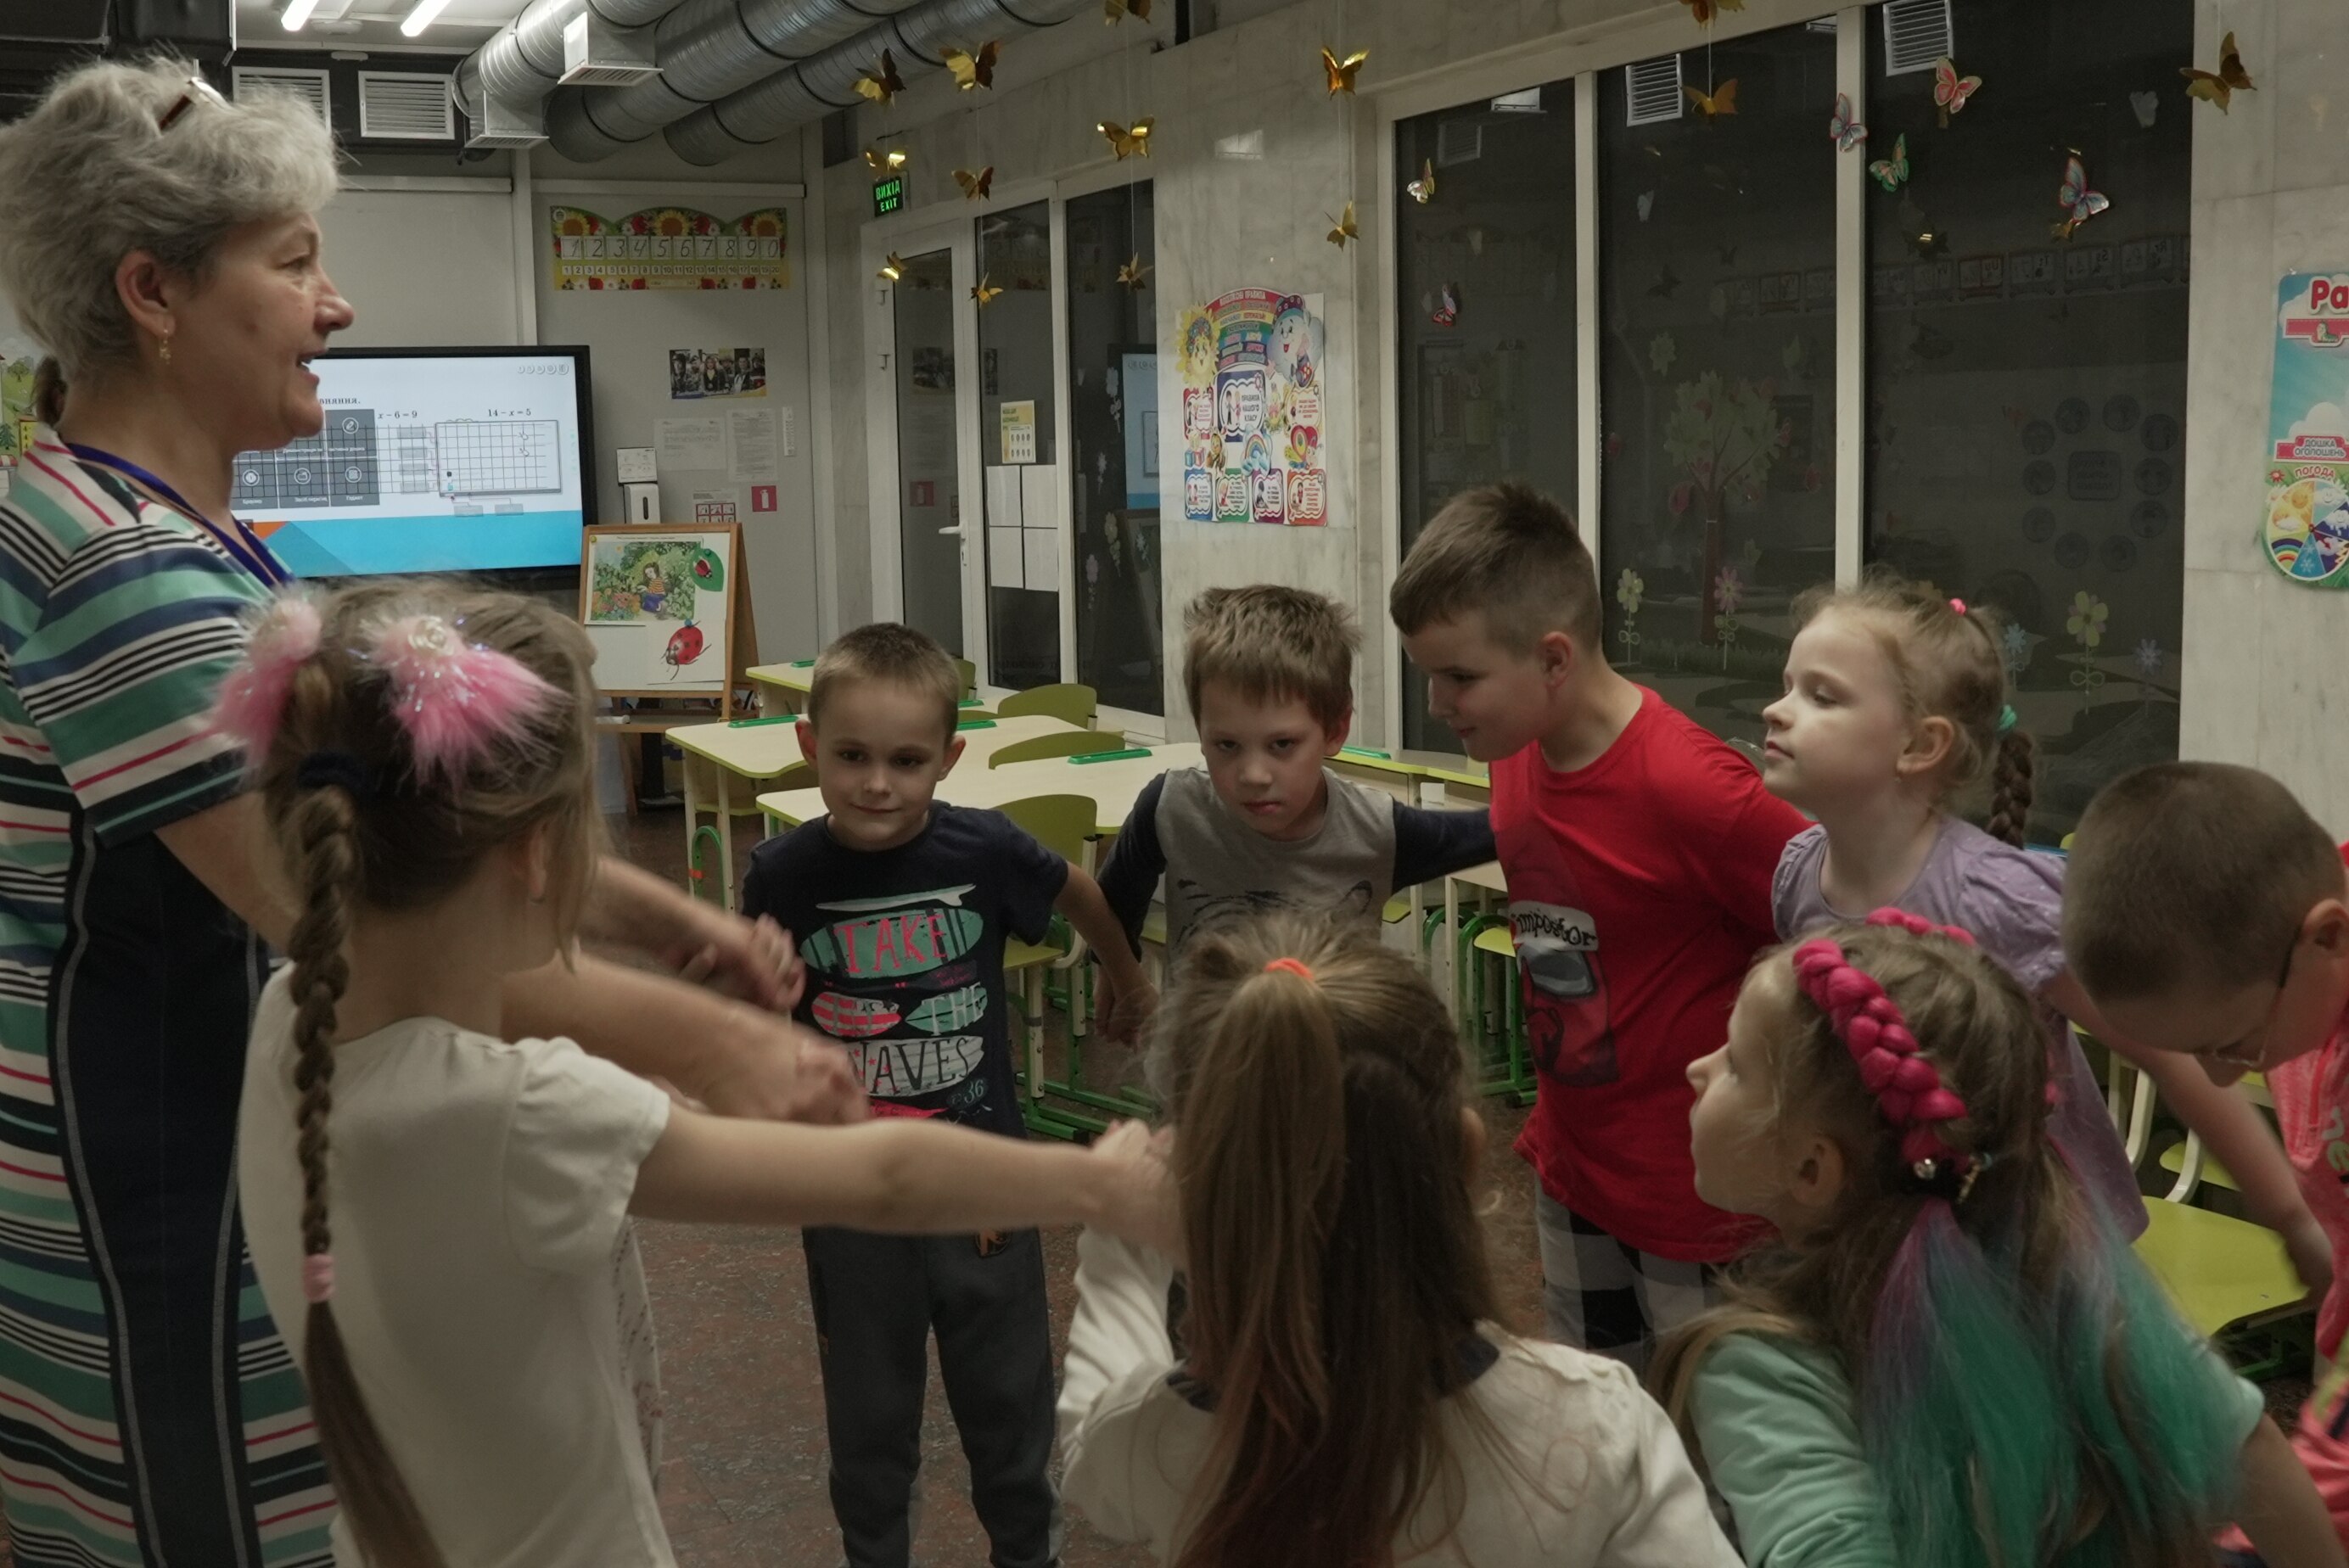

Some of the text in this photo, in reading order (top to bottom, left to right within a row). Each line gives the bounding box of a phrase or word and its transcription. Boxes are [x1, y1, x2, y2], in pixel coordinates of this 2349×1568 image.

[876, 180, 900, 200] ВИХІД
[880, 197, 898, 212] EXIT
[571, 238, 778, 257] 1 2 3 4 5 6 7 8 9 0
[2295, 448, 2345, 456] ОГОЛОШЕНЬ
[2305, 440, 2336, 448] ДОШКА
[2295, 466, 2335, 477] ПОГОДА
[833, 914, 949, 973] TAKE
[921, 982, 984, 1036] THE
